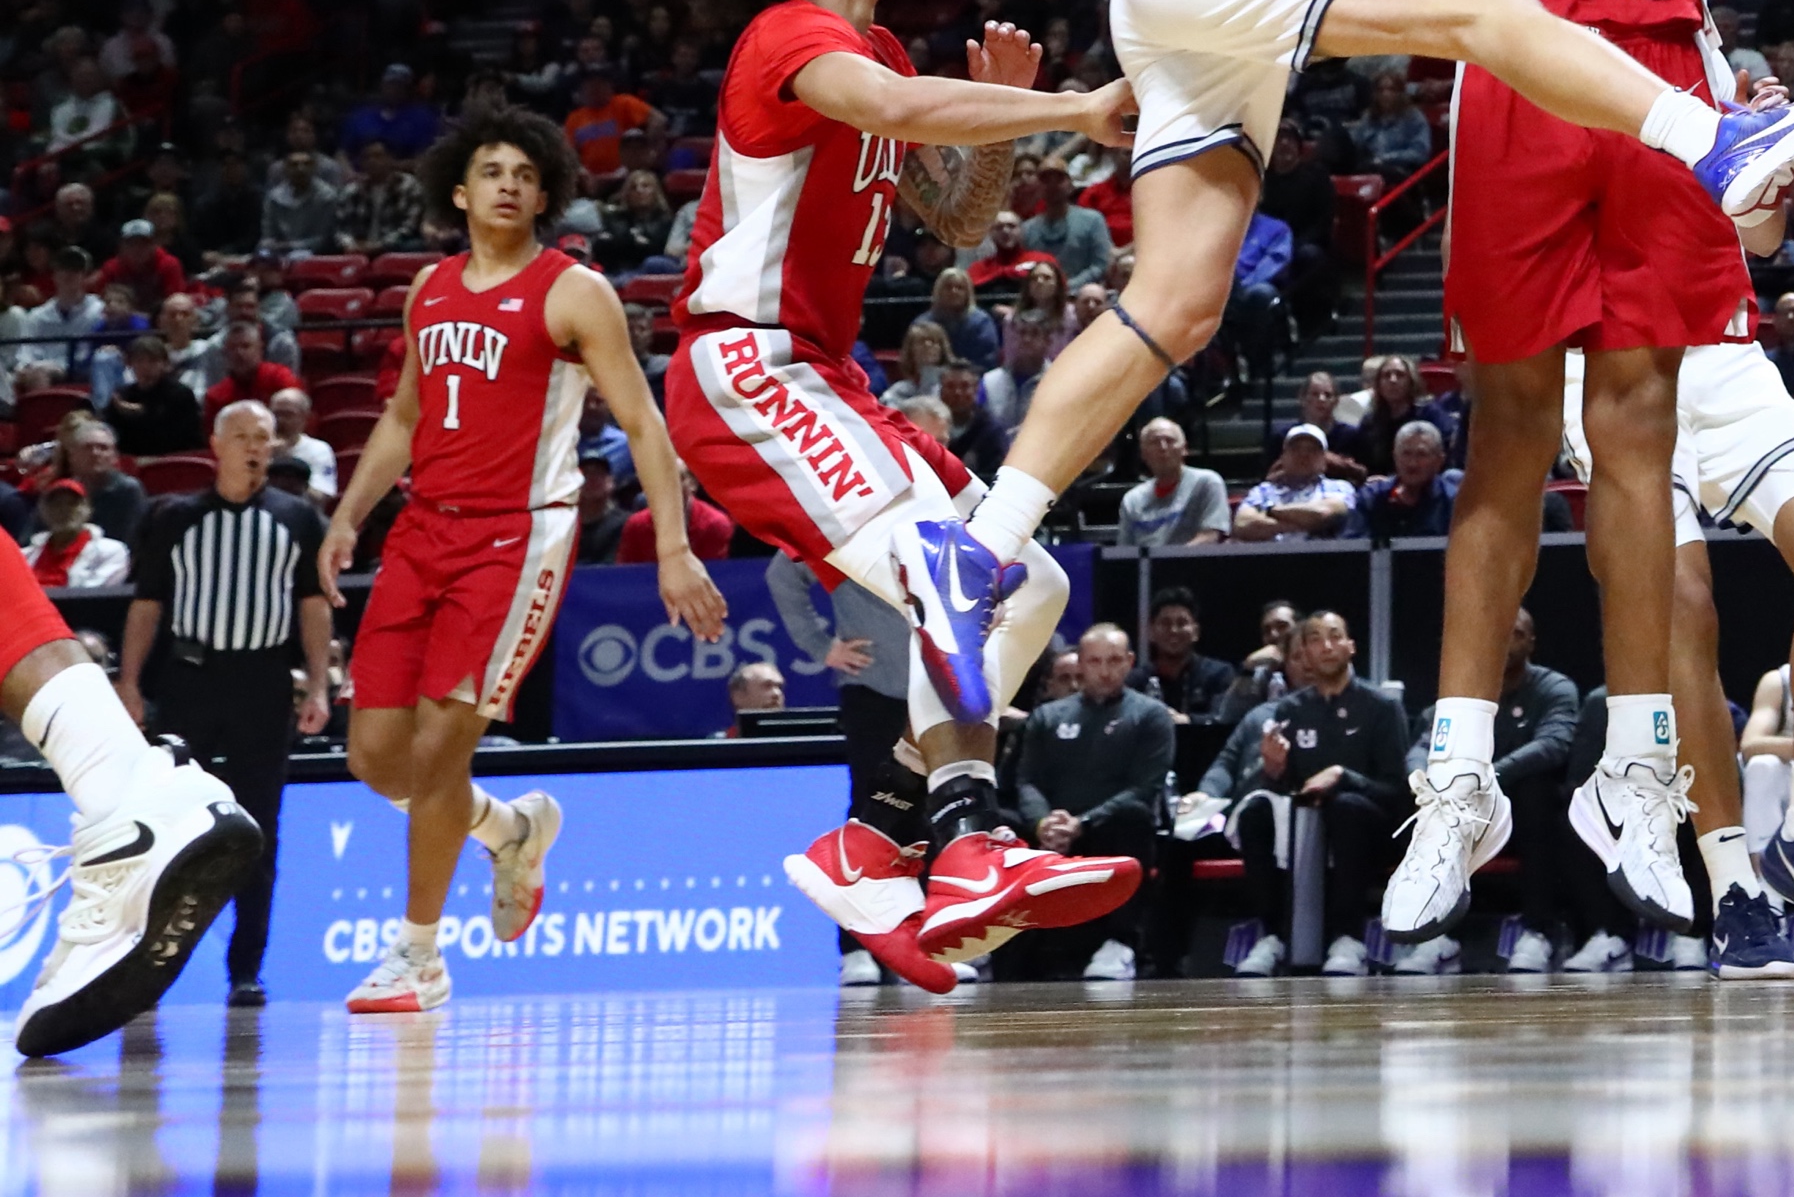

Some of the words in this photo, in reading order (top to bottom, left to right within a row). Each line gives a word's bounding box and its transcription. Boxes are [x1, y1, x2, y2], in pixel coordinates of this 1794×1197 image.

[418, 321, 509, 381] UNLV
[443, 374, 461, 430] 1
[718, 331, 875, 503] RUNNIN'
[640, 618, 778, 682] CBS
[573, 906, 783, 955] NETWORK
